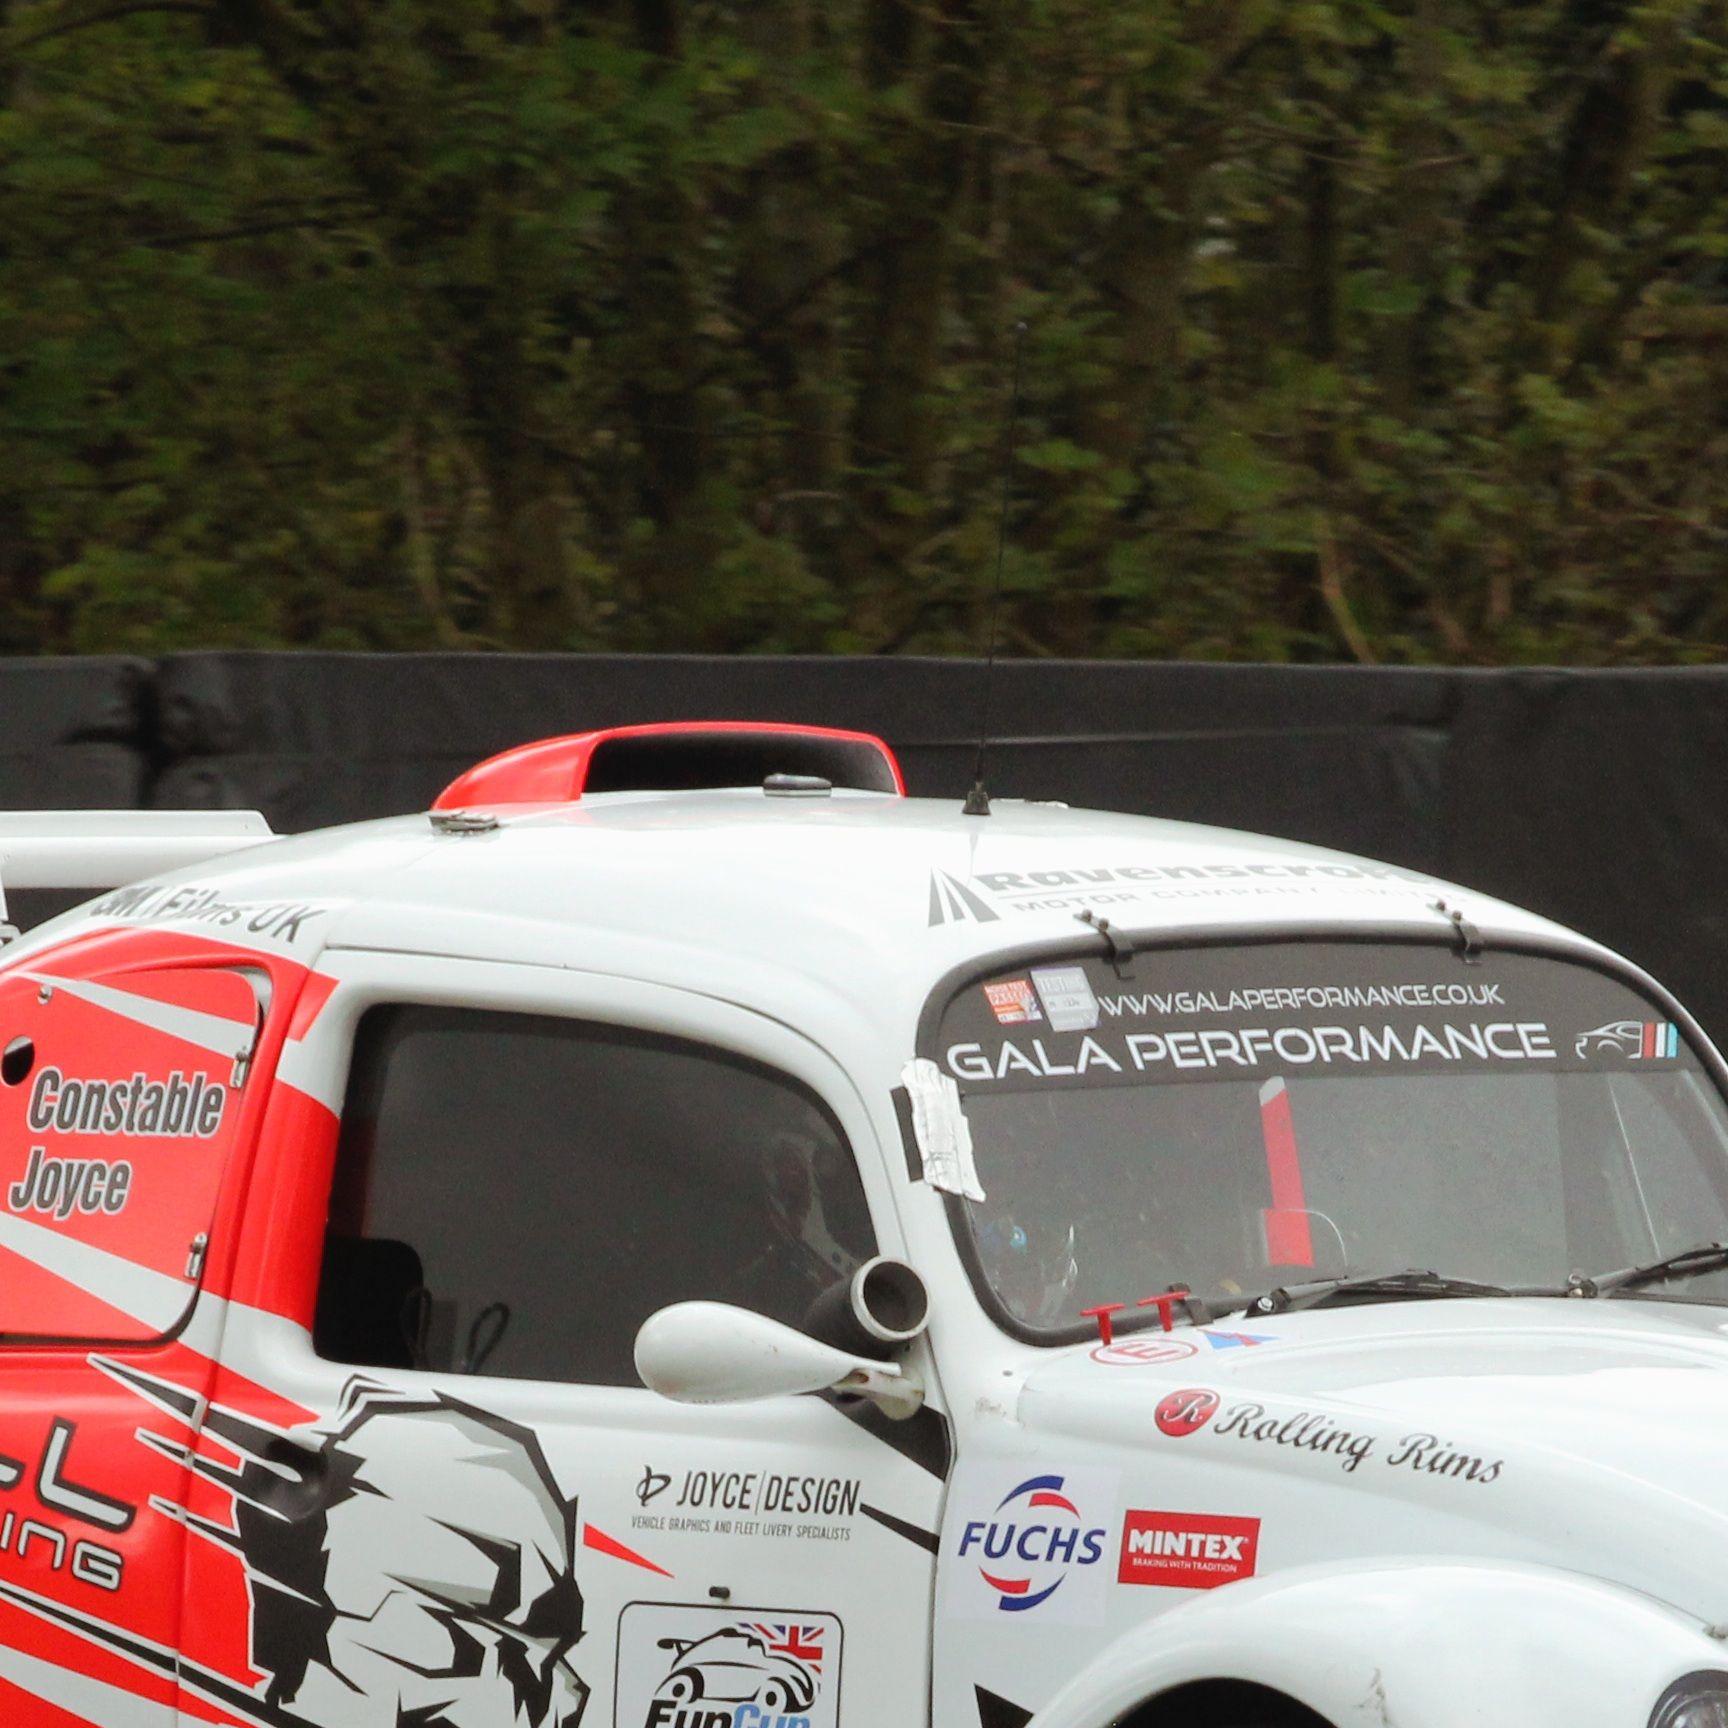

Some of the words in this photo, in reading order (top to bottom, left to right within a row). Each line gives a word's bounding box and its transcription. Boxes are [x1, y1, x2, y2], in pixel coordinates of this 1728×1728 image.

[154, 887, 249, 926] Films
[248, 903, 326, 943] UK
[1010, 892, 1142, 912] MOTOR
[1097, 983, 1505, 1016] WWW.GALAPERFORMANCE.CO.UK
[946, 1036, 1122, 1081] GALA
[1125, 1022, 1557, 1071] PERFORMANCE
[27, 1067, 225, 1138] Constable
[9, 1147, 132, 1220] Joyce
[1213, 1404, 1377, 1473] Rolling
[1386, 1432, 1505, 1484] Rims
[676, 1469, 758, 1510] JOYCE
[764, 1475, 861, 1516] DESIGN
[631, 1515, 665, 1531] VEHICLE
[668, 1517, 710, 1533] GRAPHICS
[714, 1519, 731, 1534] AND
[734, 1521, 760, 1536] FLEET
[762, 1522, 793, 1538] LIVERY
[796, 1524, 851, 1541] SPECIALISTS
[958, 1521, 1107, 1566] FUCHS
[1128, 1528, 1245, 1561] MINTEX
[1132, 1557, 1168, 1568] BRAKING
[1169, 1559, 1191, 1570] WITH
[1192, 1561, 1237, 1573] TRADITION
